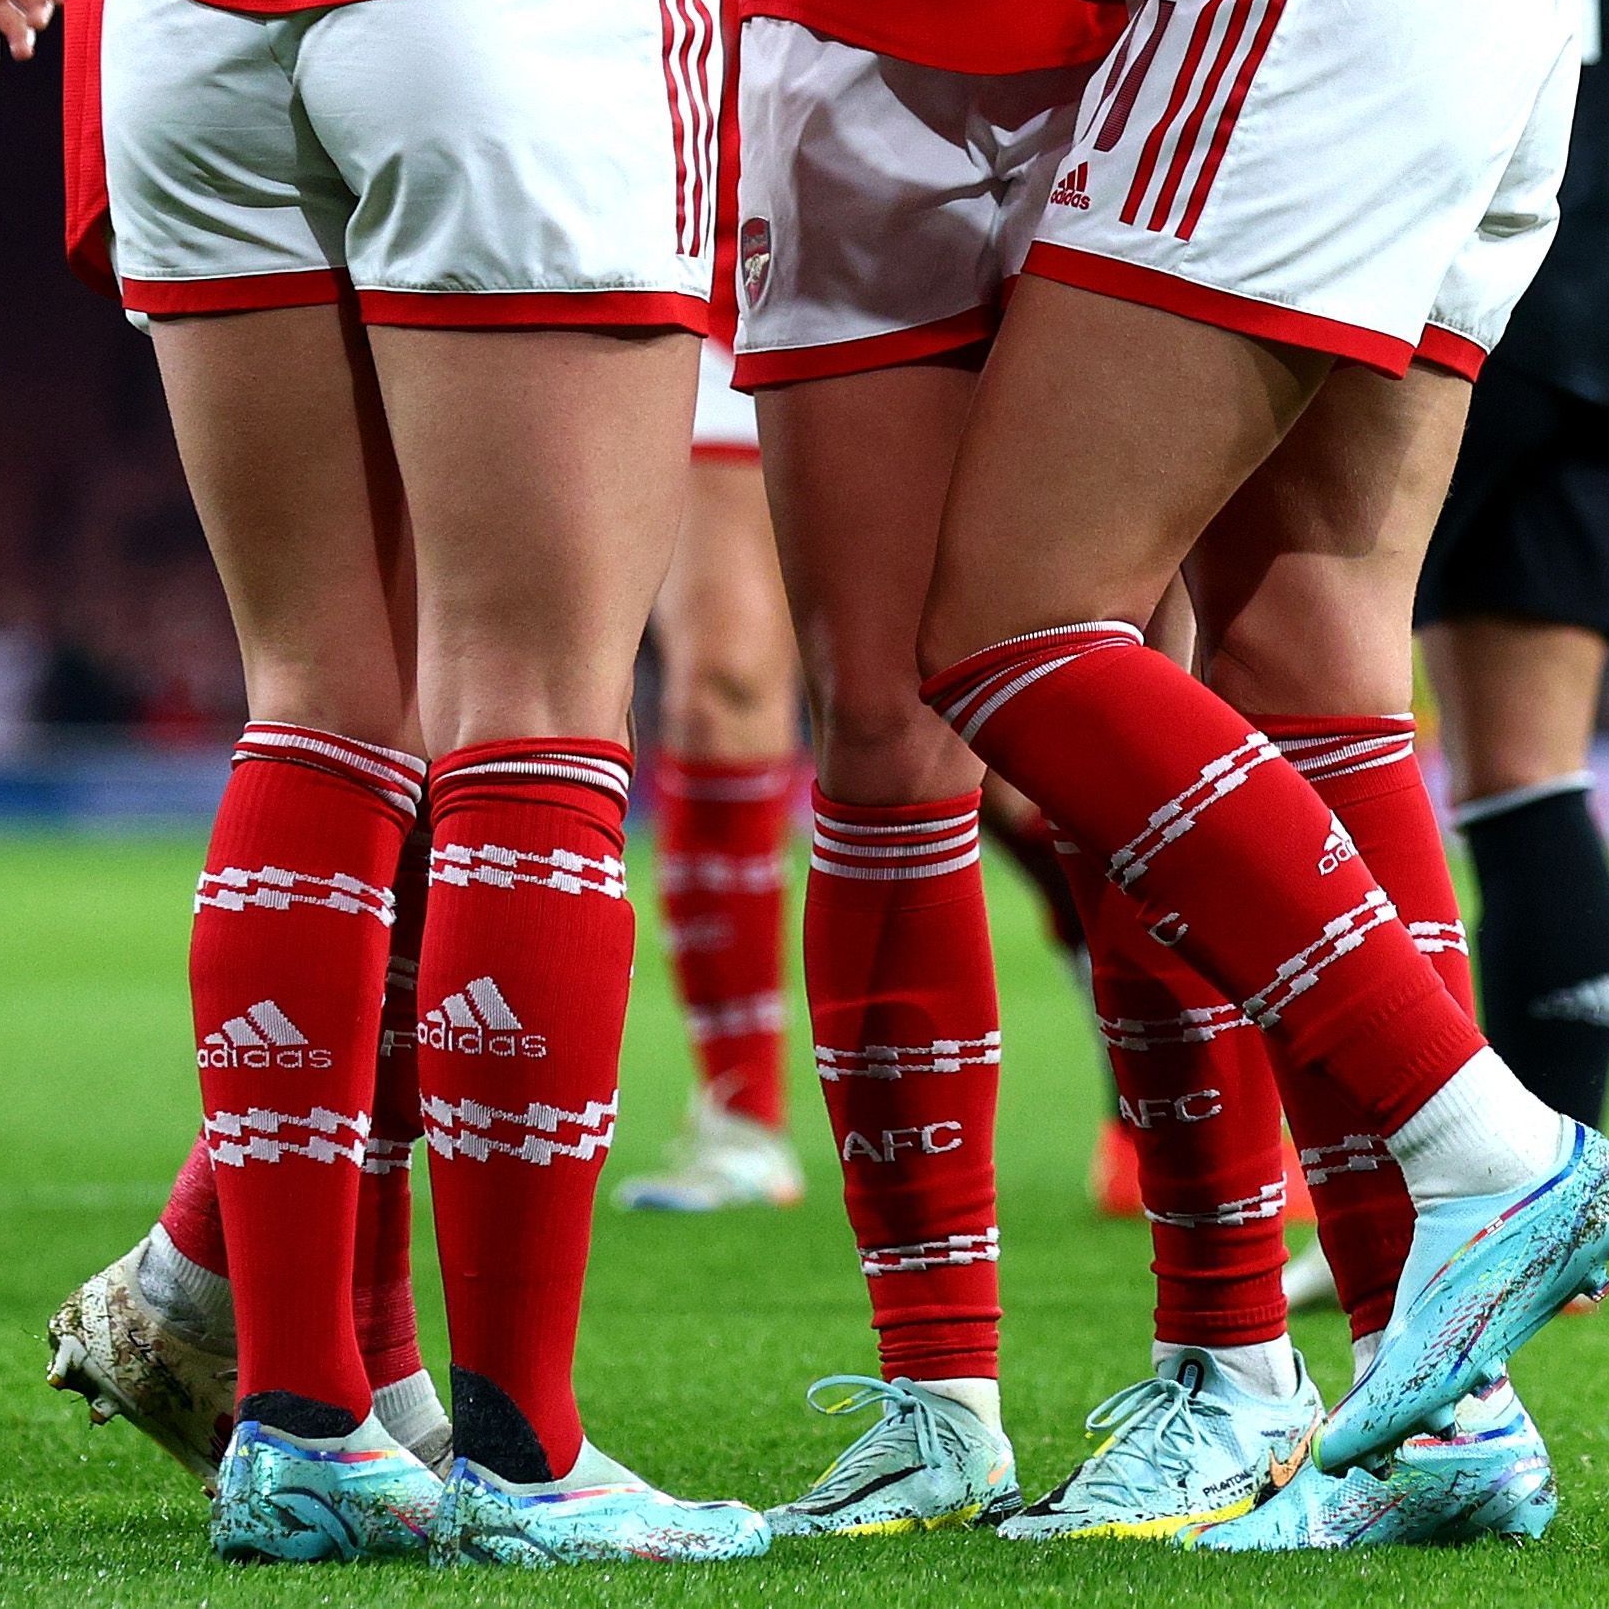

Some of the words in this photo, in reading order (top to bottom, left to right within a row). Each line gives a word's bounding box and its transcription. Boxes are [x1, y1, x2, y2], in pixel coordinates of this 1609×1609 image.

[1050, 190, 1092, 211] adidas
[196, 1042, 333, 1069] adidas
[417, 1020, 547, 1058] adidas
[1118, 1089, 1222, 1129] AFC
[842, 1119, 963, 1163] AFC
